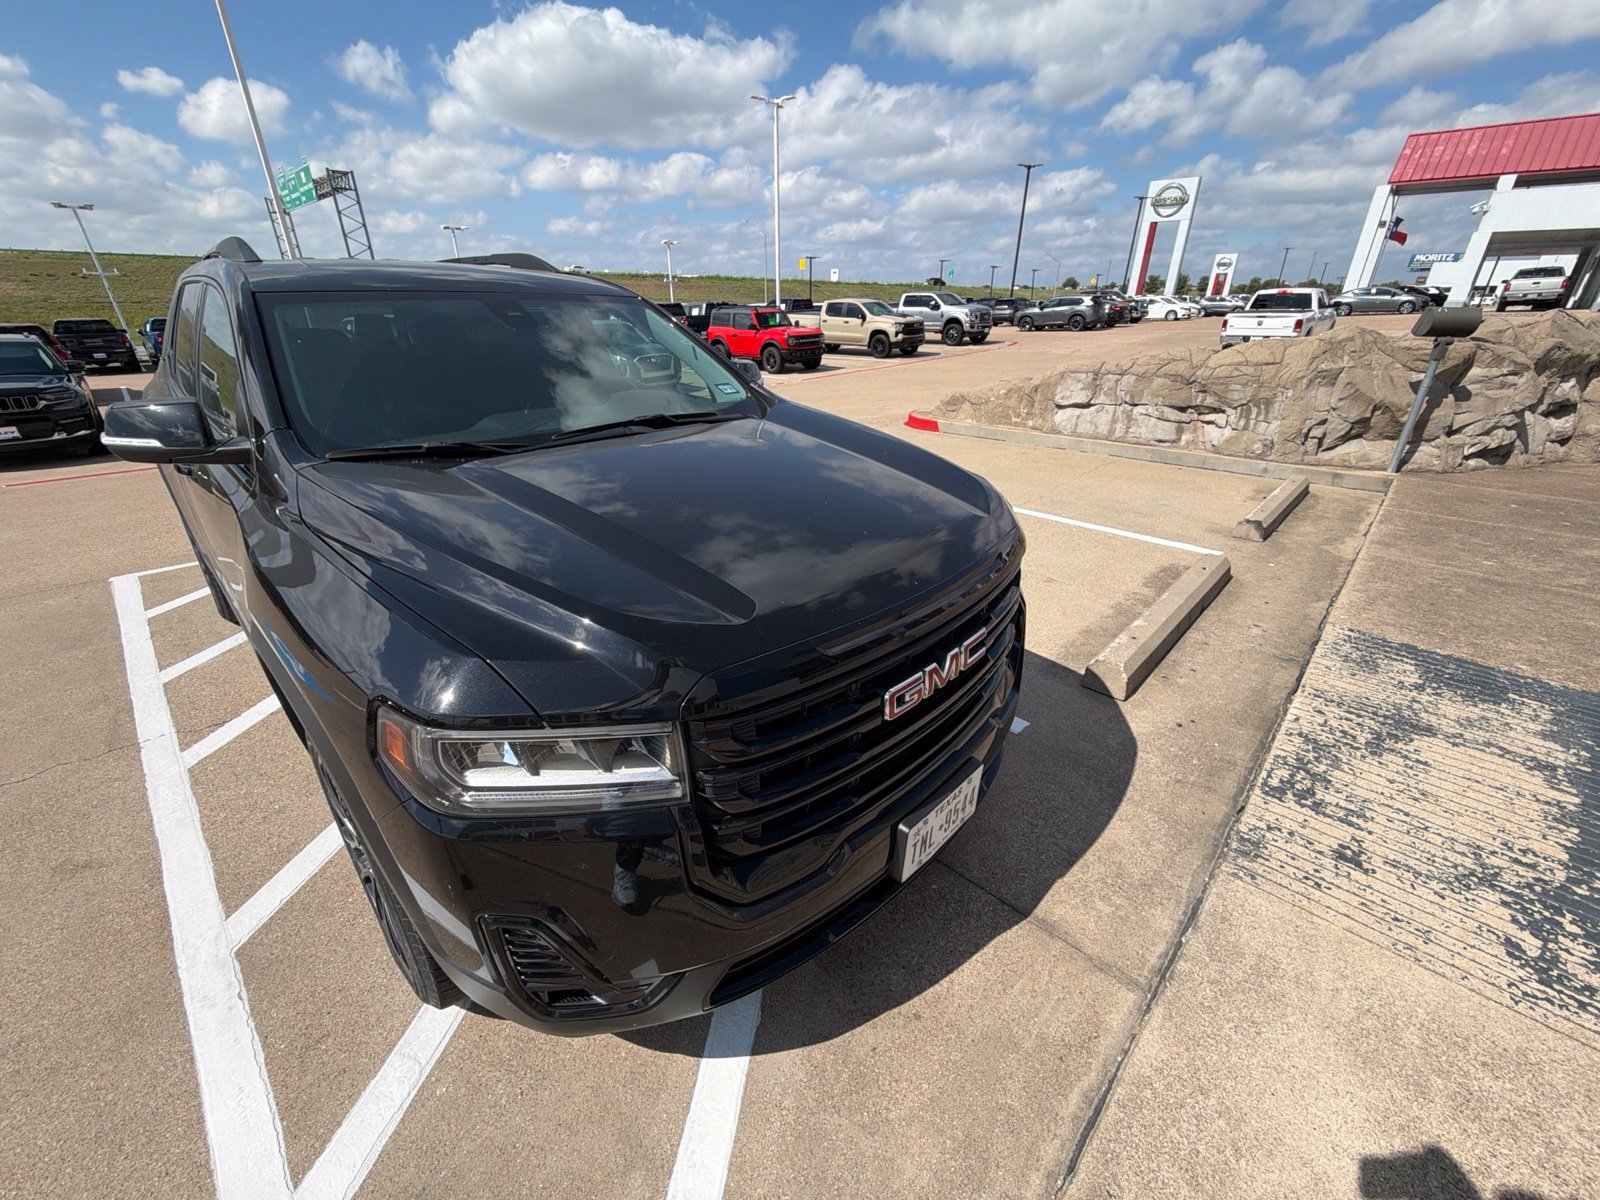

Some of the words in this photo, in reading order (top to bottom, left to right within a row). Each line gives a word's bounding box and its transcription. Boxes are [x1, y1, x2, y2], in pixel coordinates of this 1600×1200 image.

[1154, 195, 1186, 204] NISSAN
[1413, 253, 1455, 262] MORITZ
[884, 626, 987, 721] GMC
[934, 786, 963, 818] TEXAS
